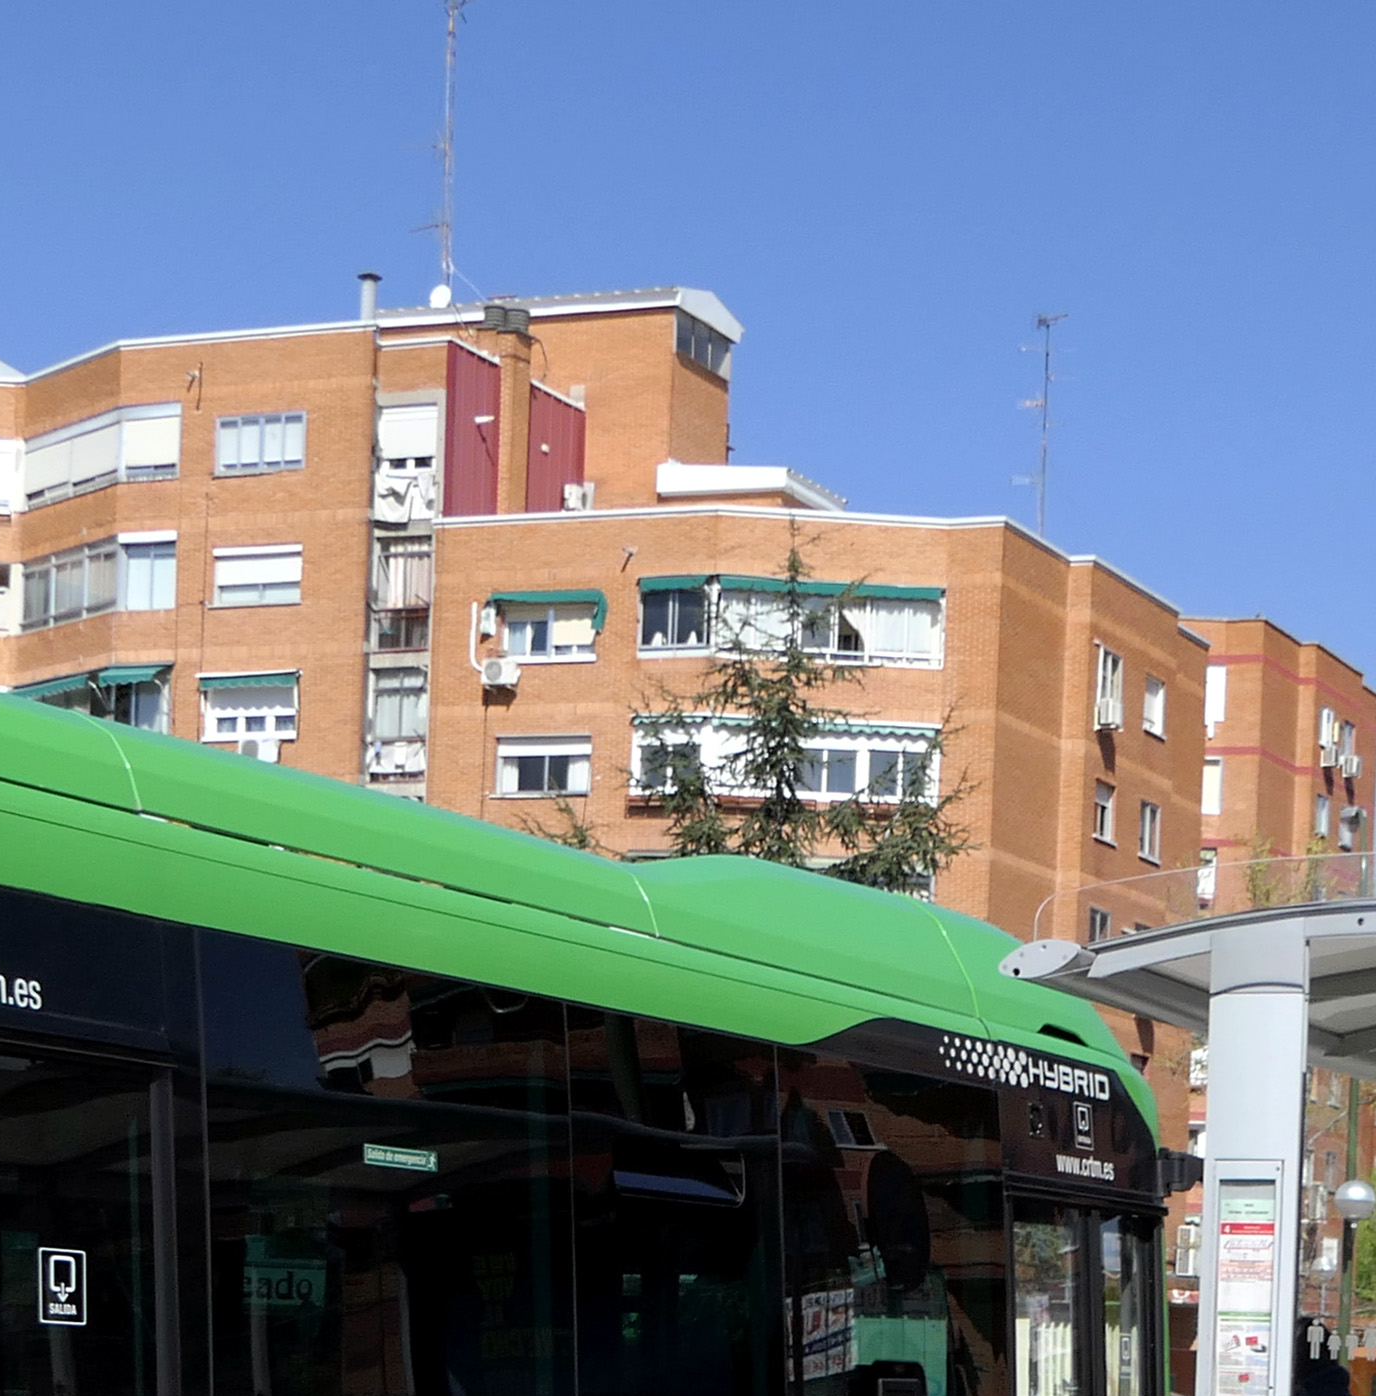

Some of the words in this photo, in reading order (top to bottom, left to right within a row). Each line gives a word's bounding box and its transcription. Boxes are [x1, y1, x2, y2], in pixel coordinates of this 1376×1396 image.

[1028, 1057, 1110, 1101] HYBRID
[1056, 1154, 1115, 1181] www.crtm.es
[49, 1302, 77, 1316] SALIDA
